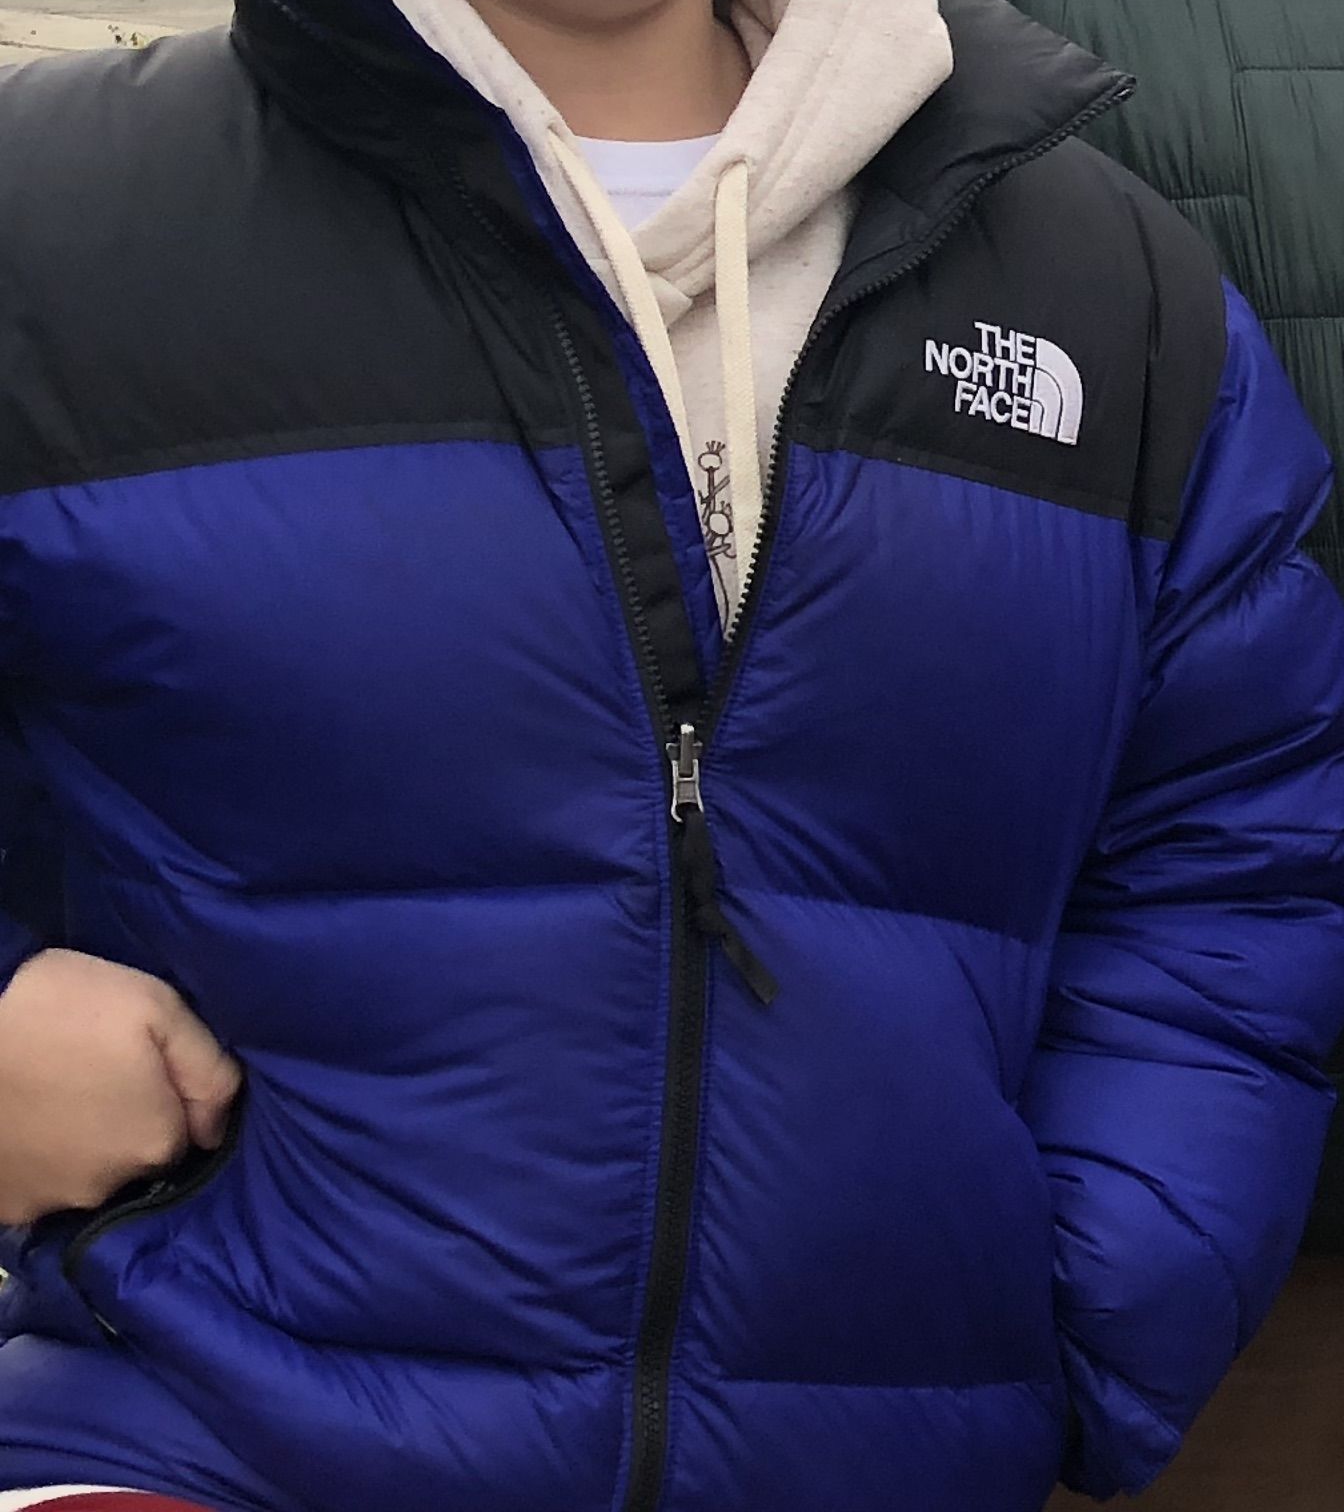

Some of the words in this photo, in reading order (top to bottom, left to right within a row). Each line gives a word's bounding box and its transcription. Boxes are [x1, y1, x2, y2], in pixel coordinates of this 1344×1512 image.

[924, 339, 1034, 399] NORTH
[974, 321, 1036, 366] THE
[954, 380, 1033, 431] FACE
